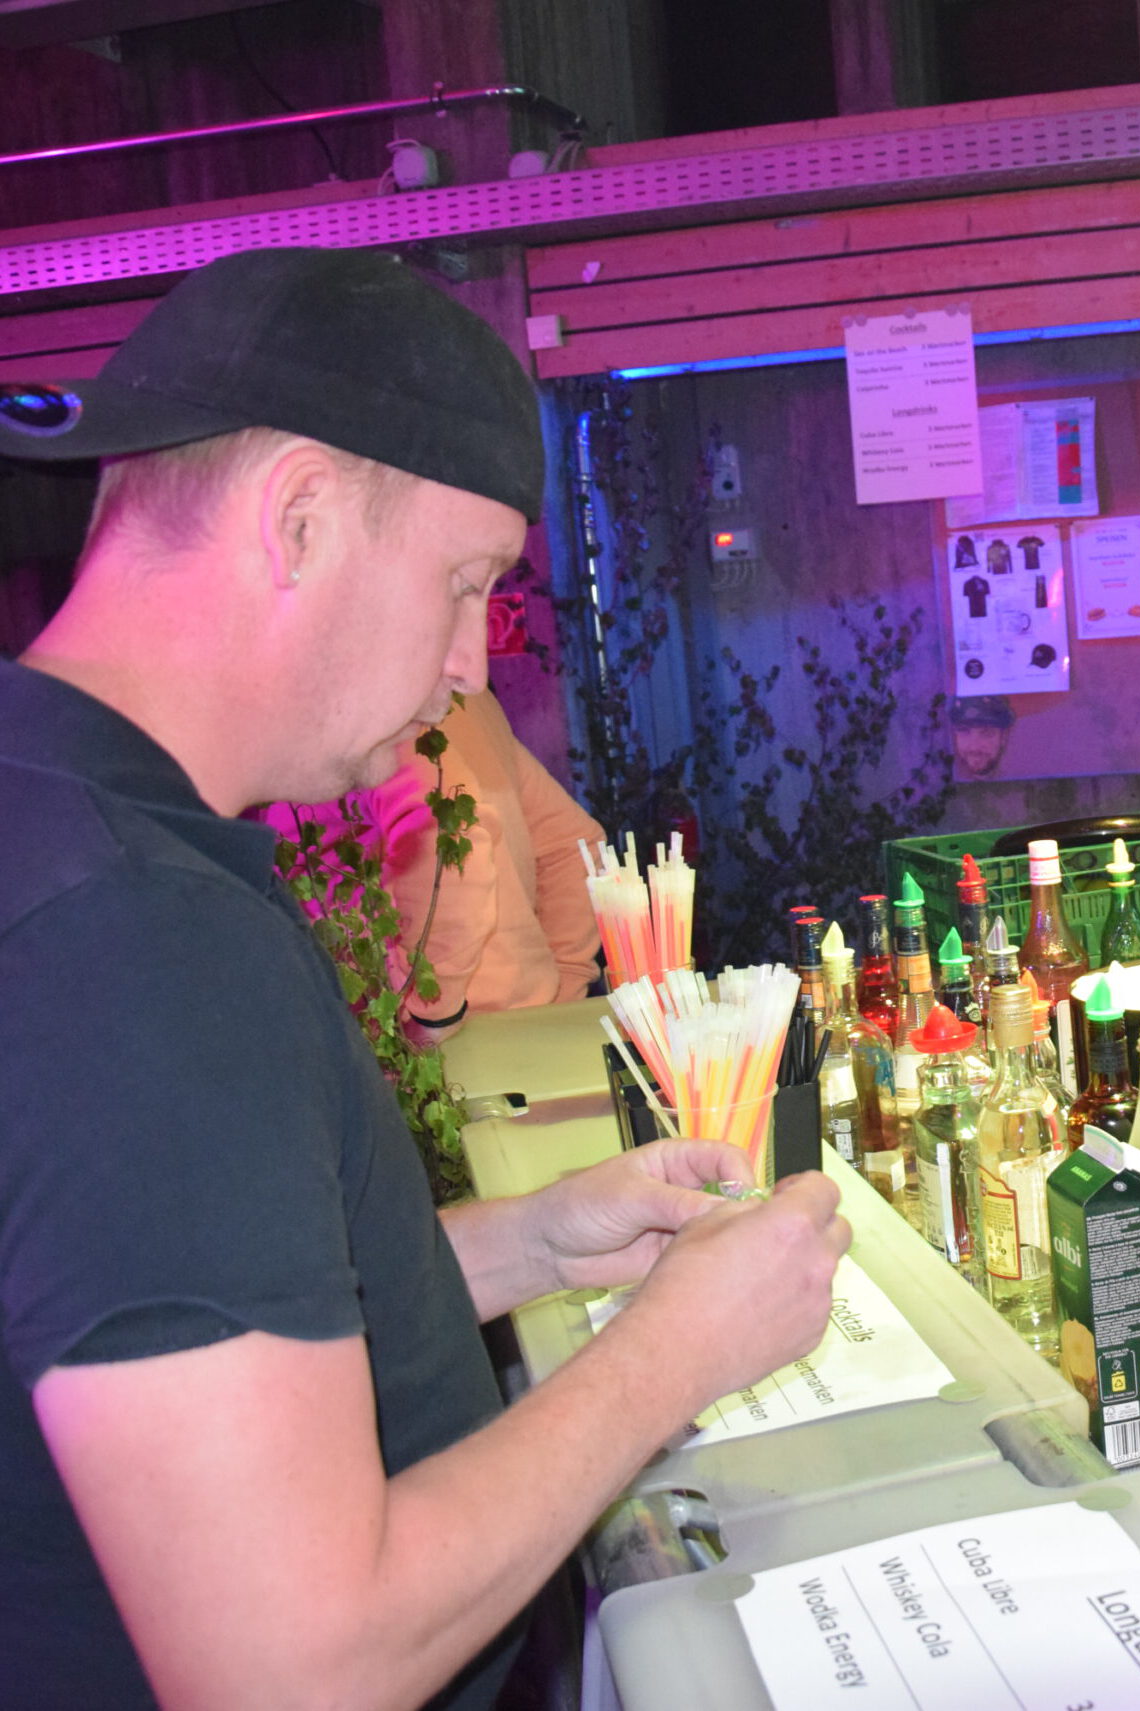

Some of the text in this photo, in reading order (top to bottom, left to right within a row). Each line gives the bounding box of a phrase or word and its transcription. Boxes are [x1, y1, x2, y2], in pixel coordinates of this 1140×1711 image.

[889, 322, 928, 336] Cocktails
[892, 404, 938, 418] Longdrinks
[1053, 1236, 1082, 1268] albi
[832, 1298, 875, 1342] Cocktails
[957, 1537, 1018, 1615] Cuba Libre
[880, 1556, 952, 1658] Whiskey Cola
[799, 1577, 867, 1688] Wodka Energy
